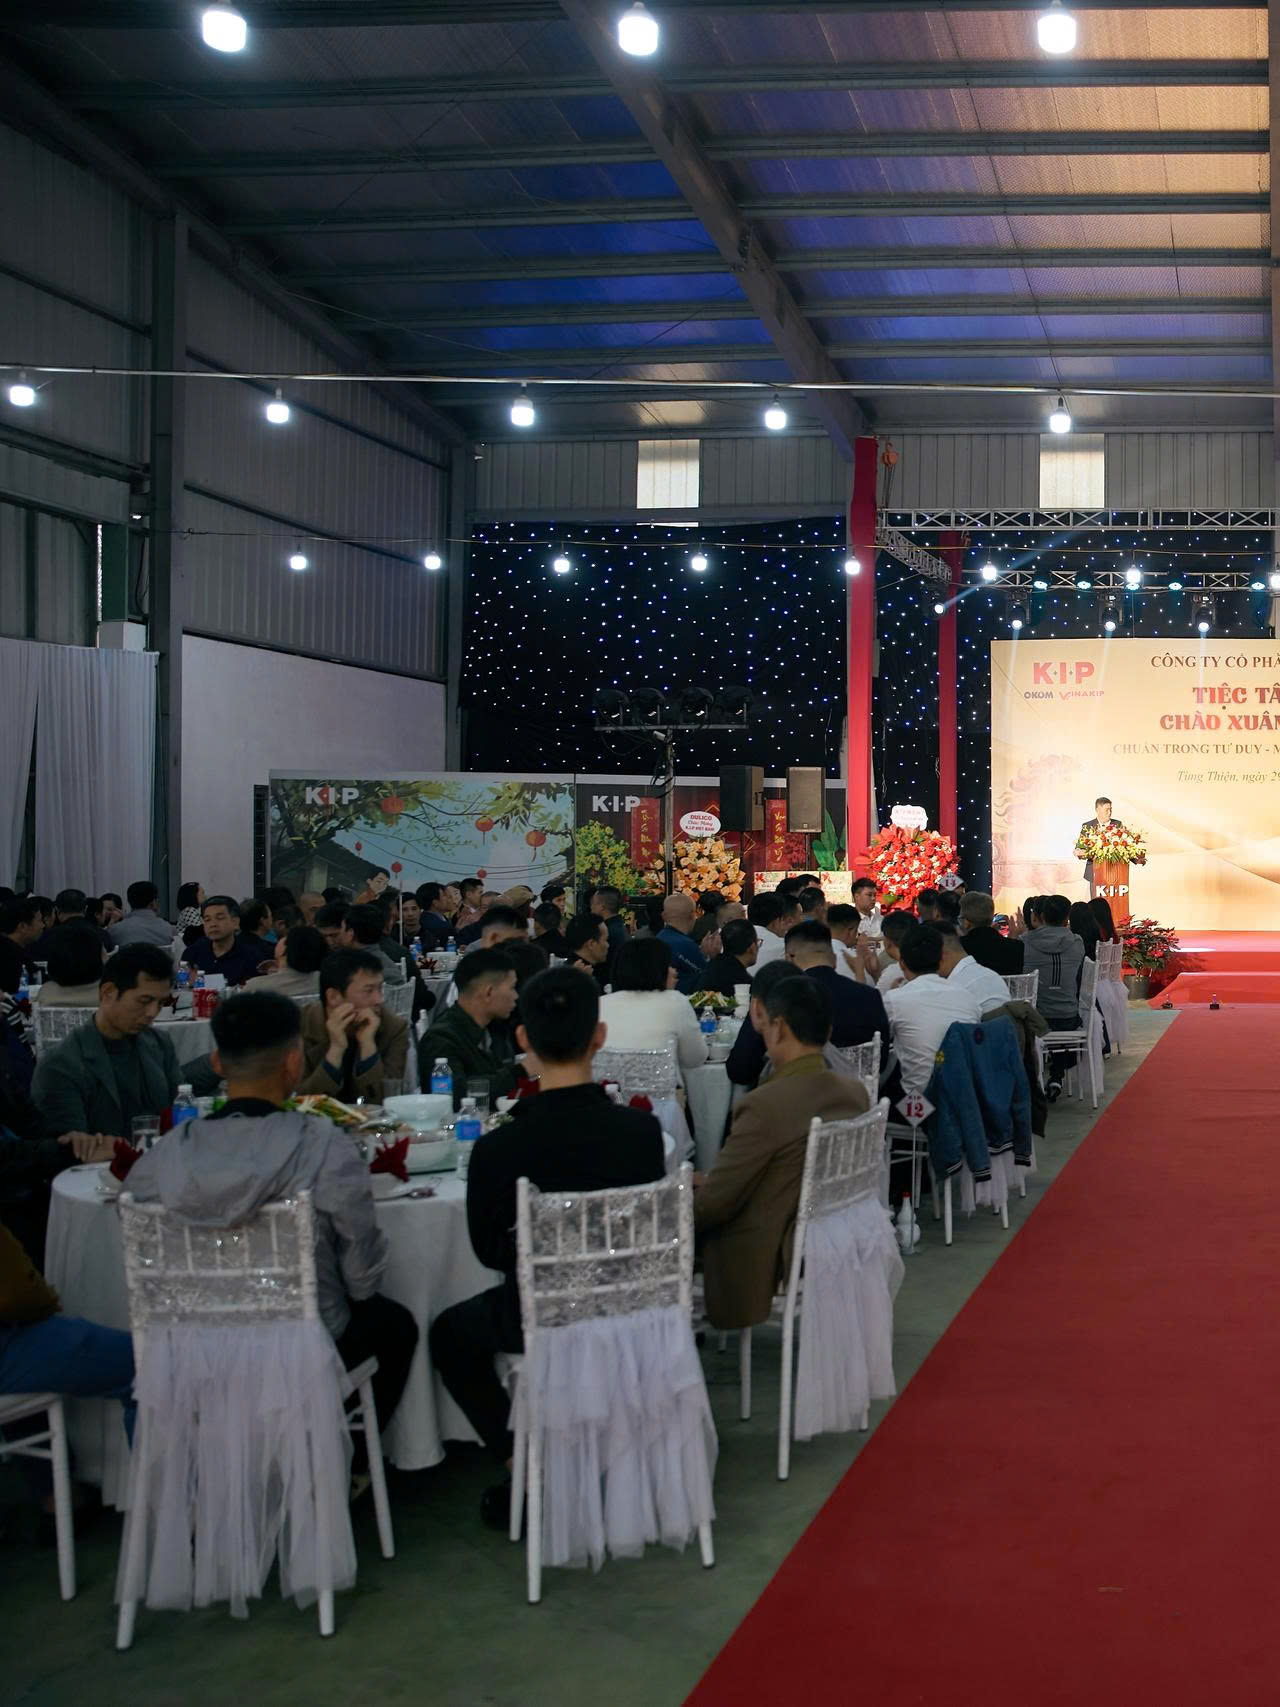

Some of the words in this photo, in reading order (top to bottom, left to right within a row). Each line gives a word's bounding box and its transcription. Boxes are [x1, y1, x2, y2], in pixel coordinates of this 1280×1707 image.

[1151, 652, 1197, 668] CÔNG
[1201, 656, 1222, 668] TY
[1192, 682, 1248, 710] TIỆC
[1159, 710, 1221, 731] CHÀO
[1163, 743, 1210, 755] TRONG
[1213, 742, 1234, 755] TƯ
[1235, 743, 1263, 755] DUY
[1242, 771, 1268, 784] ngày
[905, 1103, 925, 1118] 12
